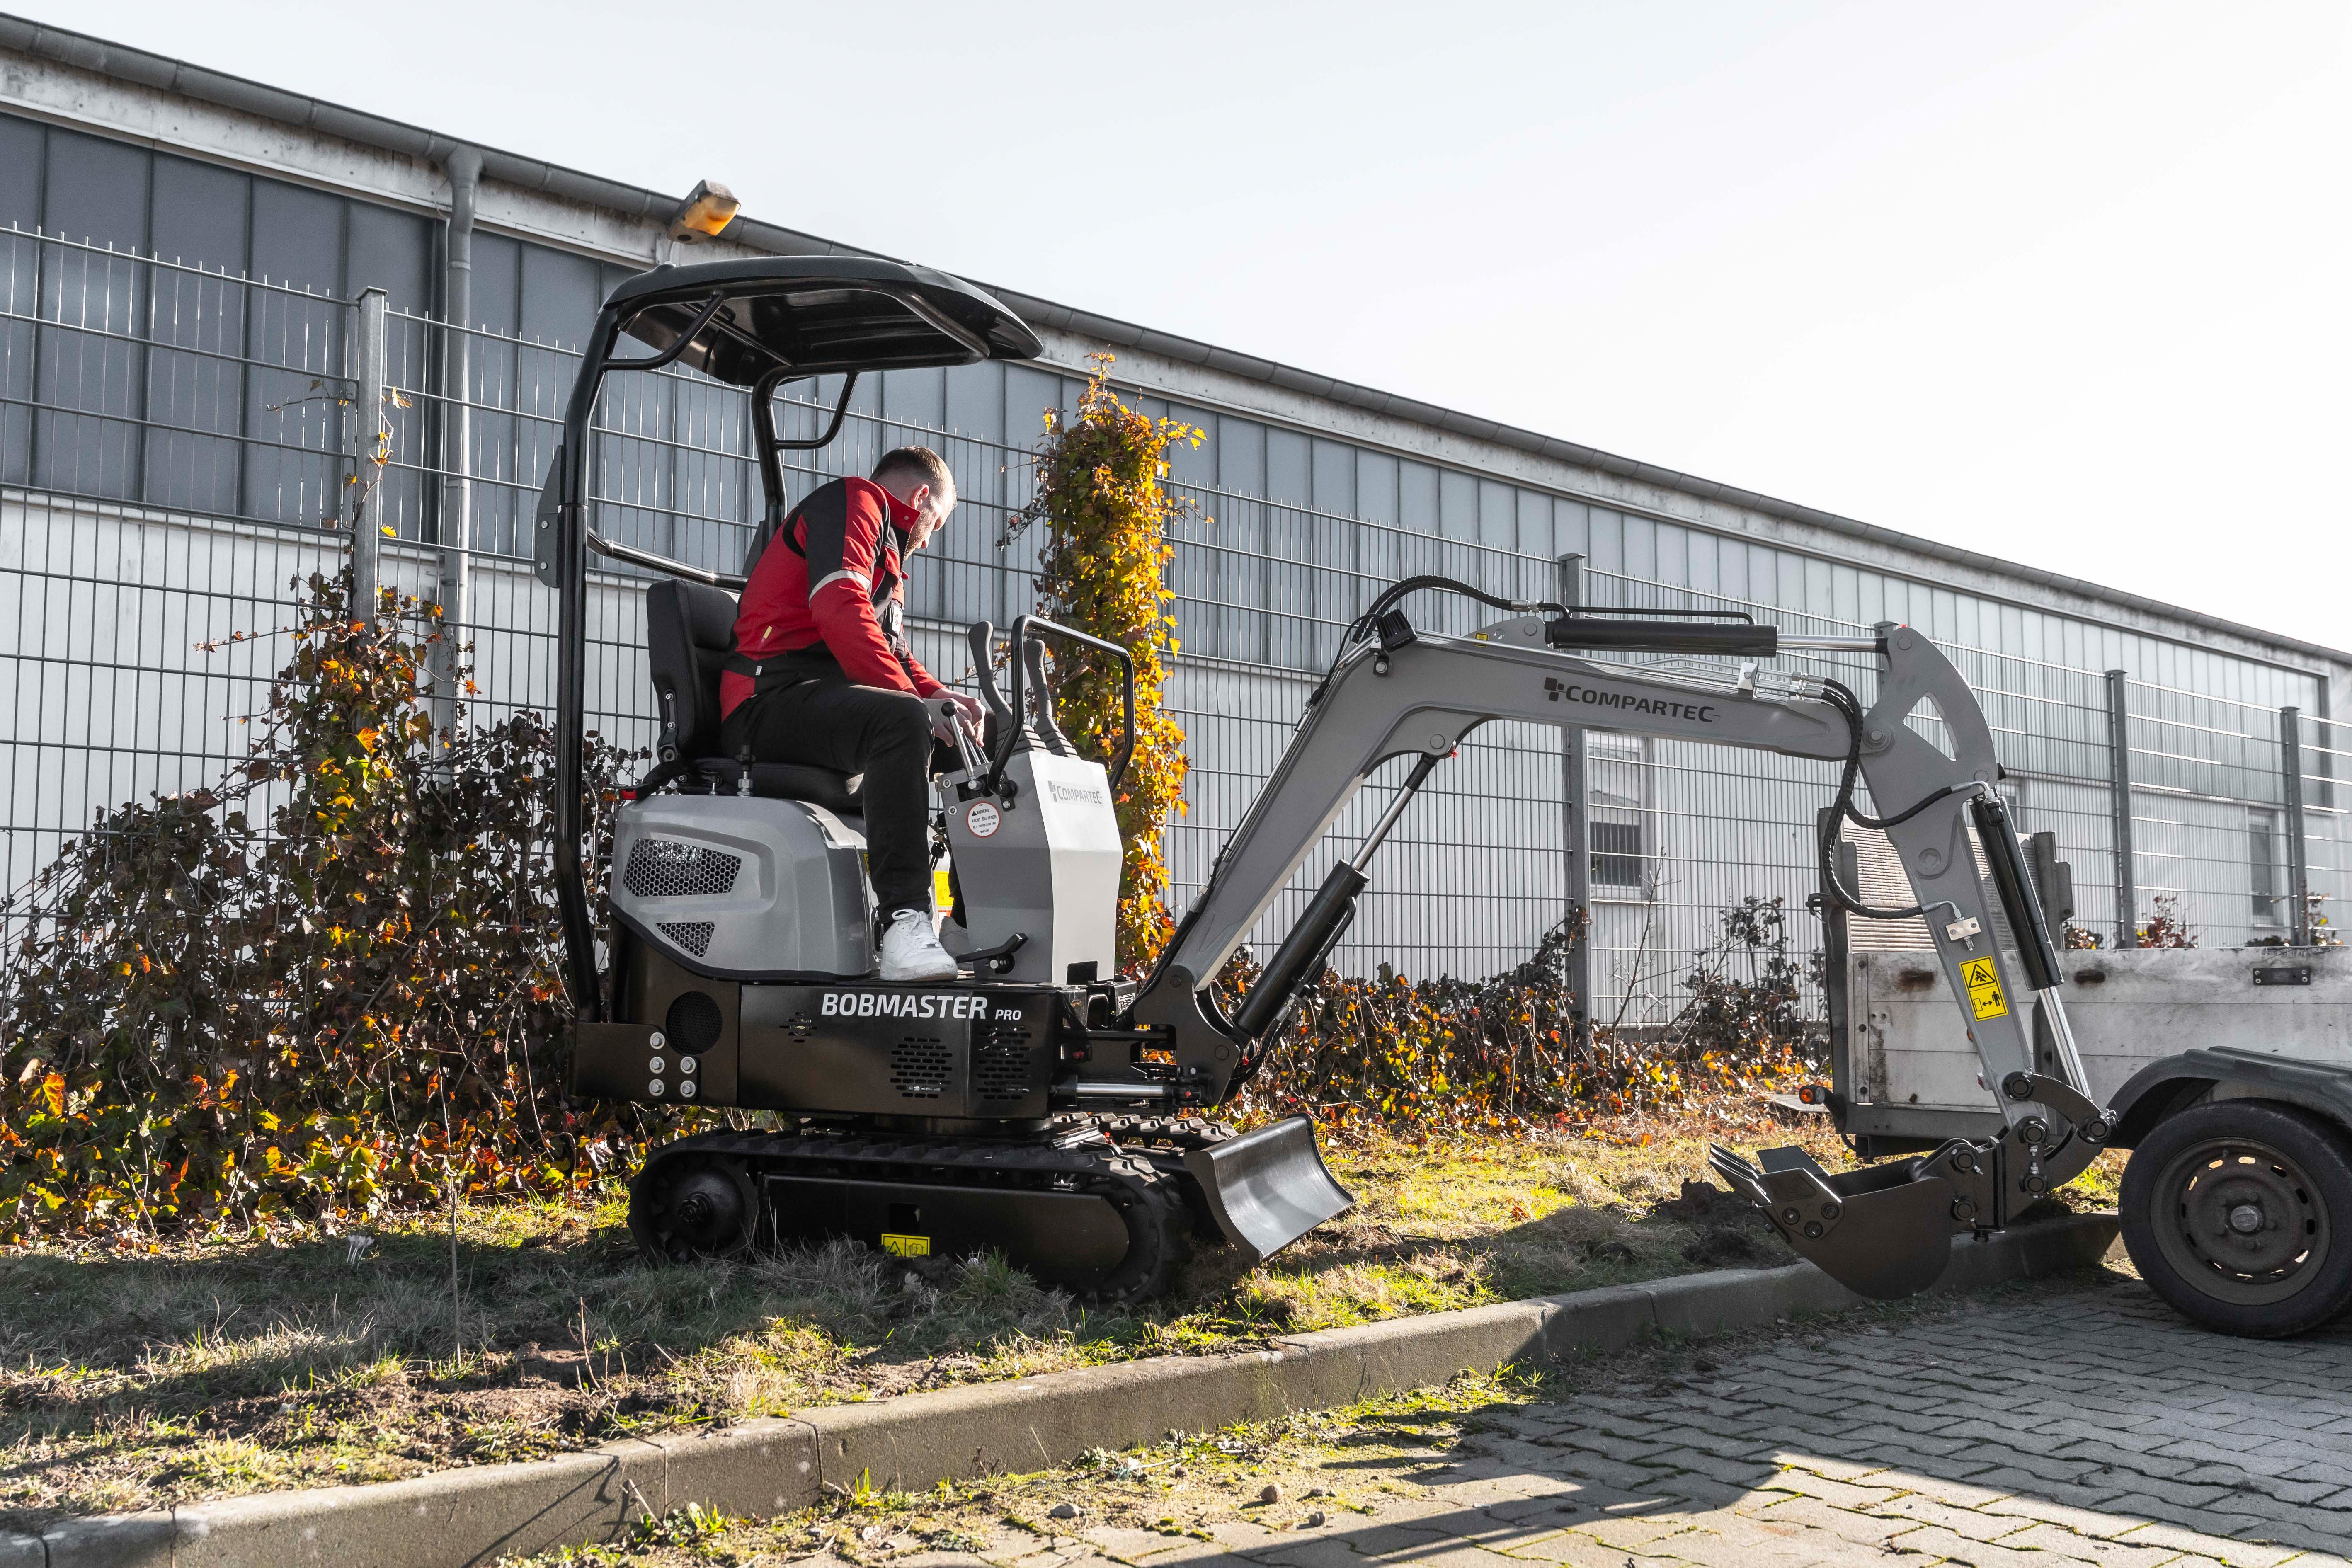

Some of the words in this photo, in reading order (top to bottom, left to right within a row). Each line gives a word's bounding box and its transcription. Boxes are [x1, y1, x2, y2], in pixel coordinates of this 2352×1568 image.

[1566, 686, 1717, 722] COMPARTEC
[1057, 785, 1102, 804] COMPARTEC
[821, 994, 988, 1020] BOBMASTER
[995, 1009, 1021, 1020] PRO
